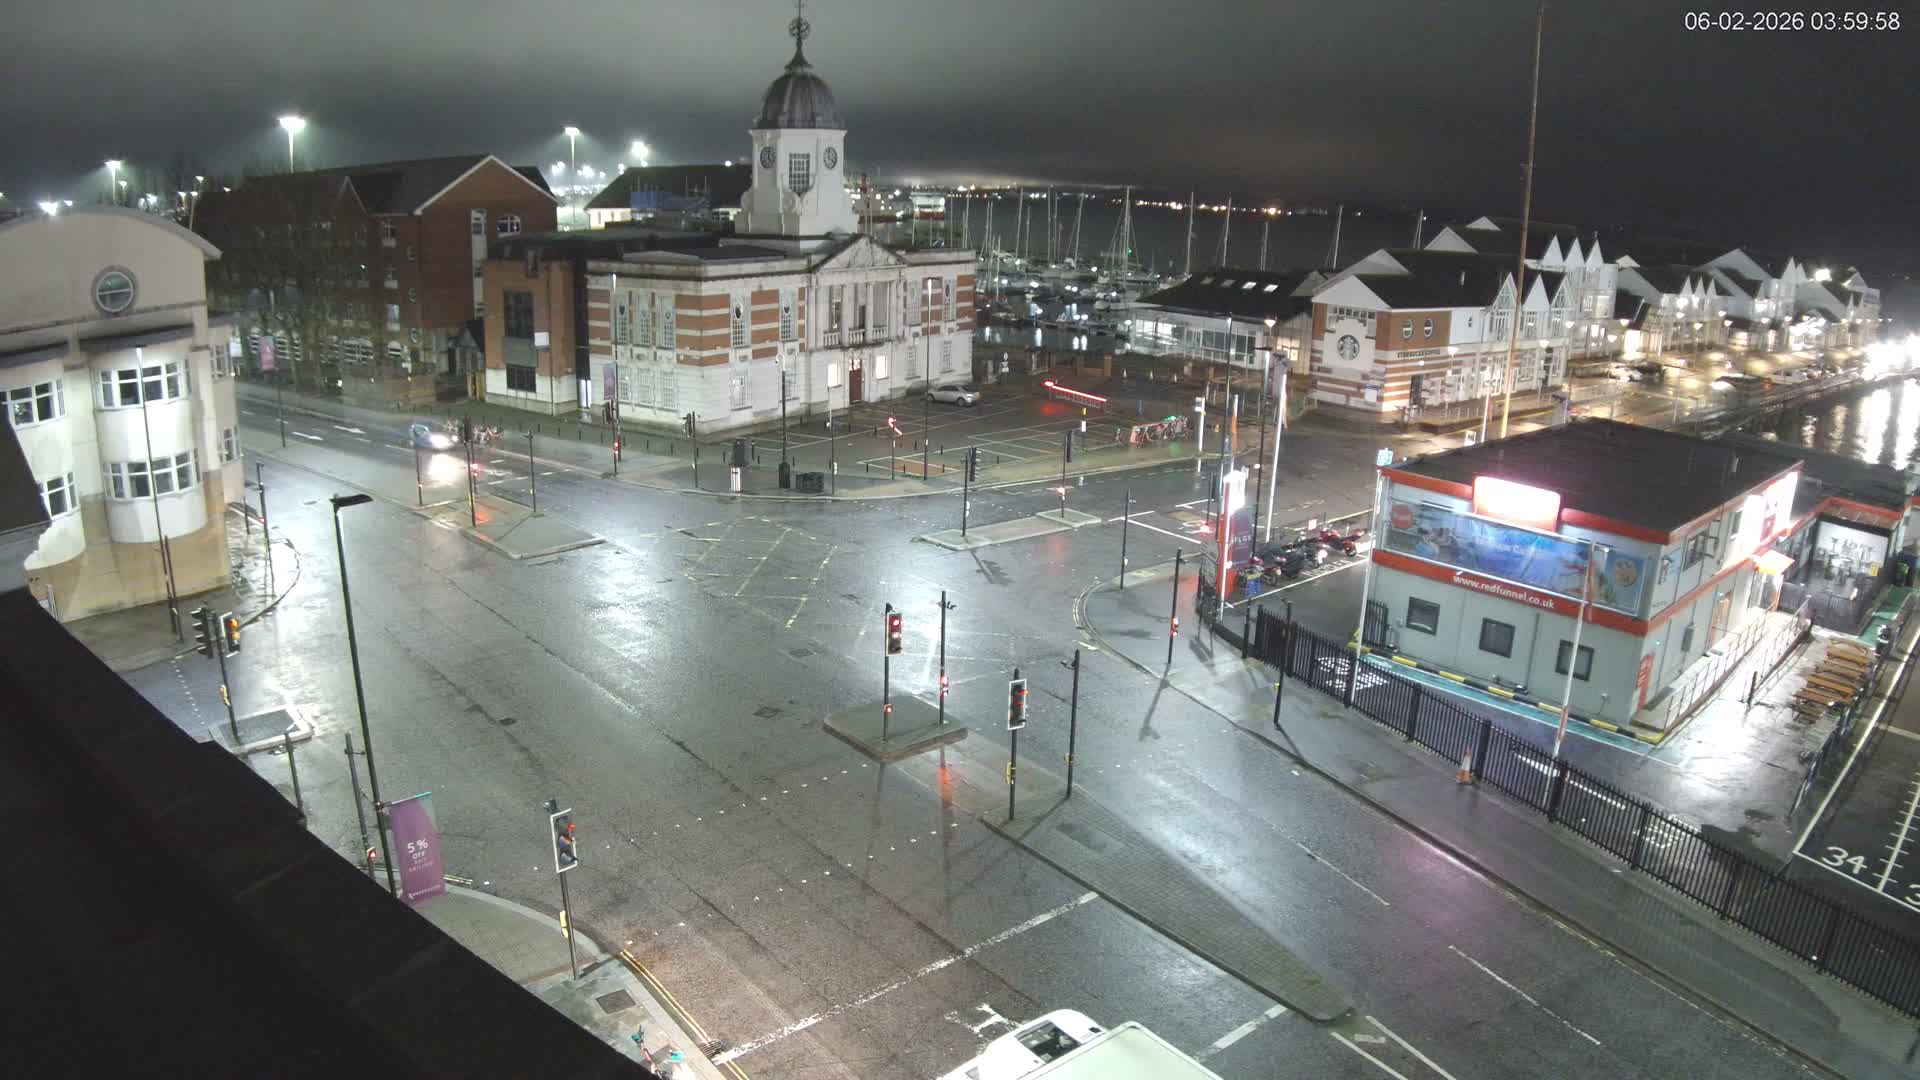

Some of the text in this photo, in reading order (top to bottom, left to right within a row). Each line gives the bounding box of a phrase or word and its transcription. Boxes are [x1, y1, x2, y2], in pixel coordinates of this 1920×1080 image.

[1452, 572, 1556, 609] www.redfunnel.co.uk
[412, 850, 426, 860] OFF
[1821, 846, 1868, 875] 34
